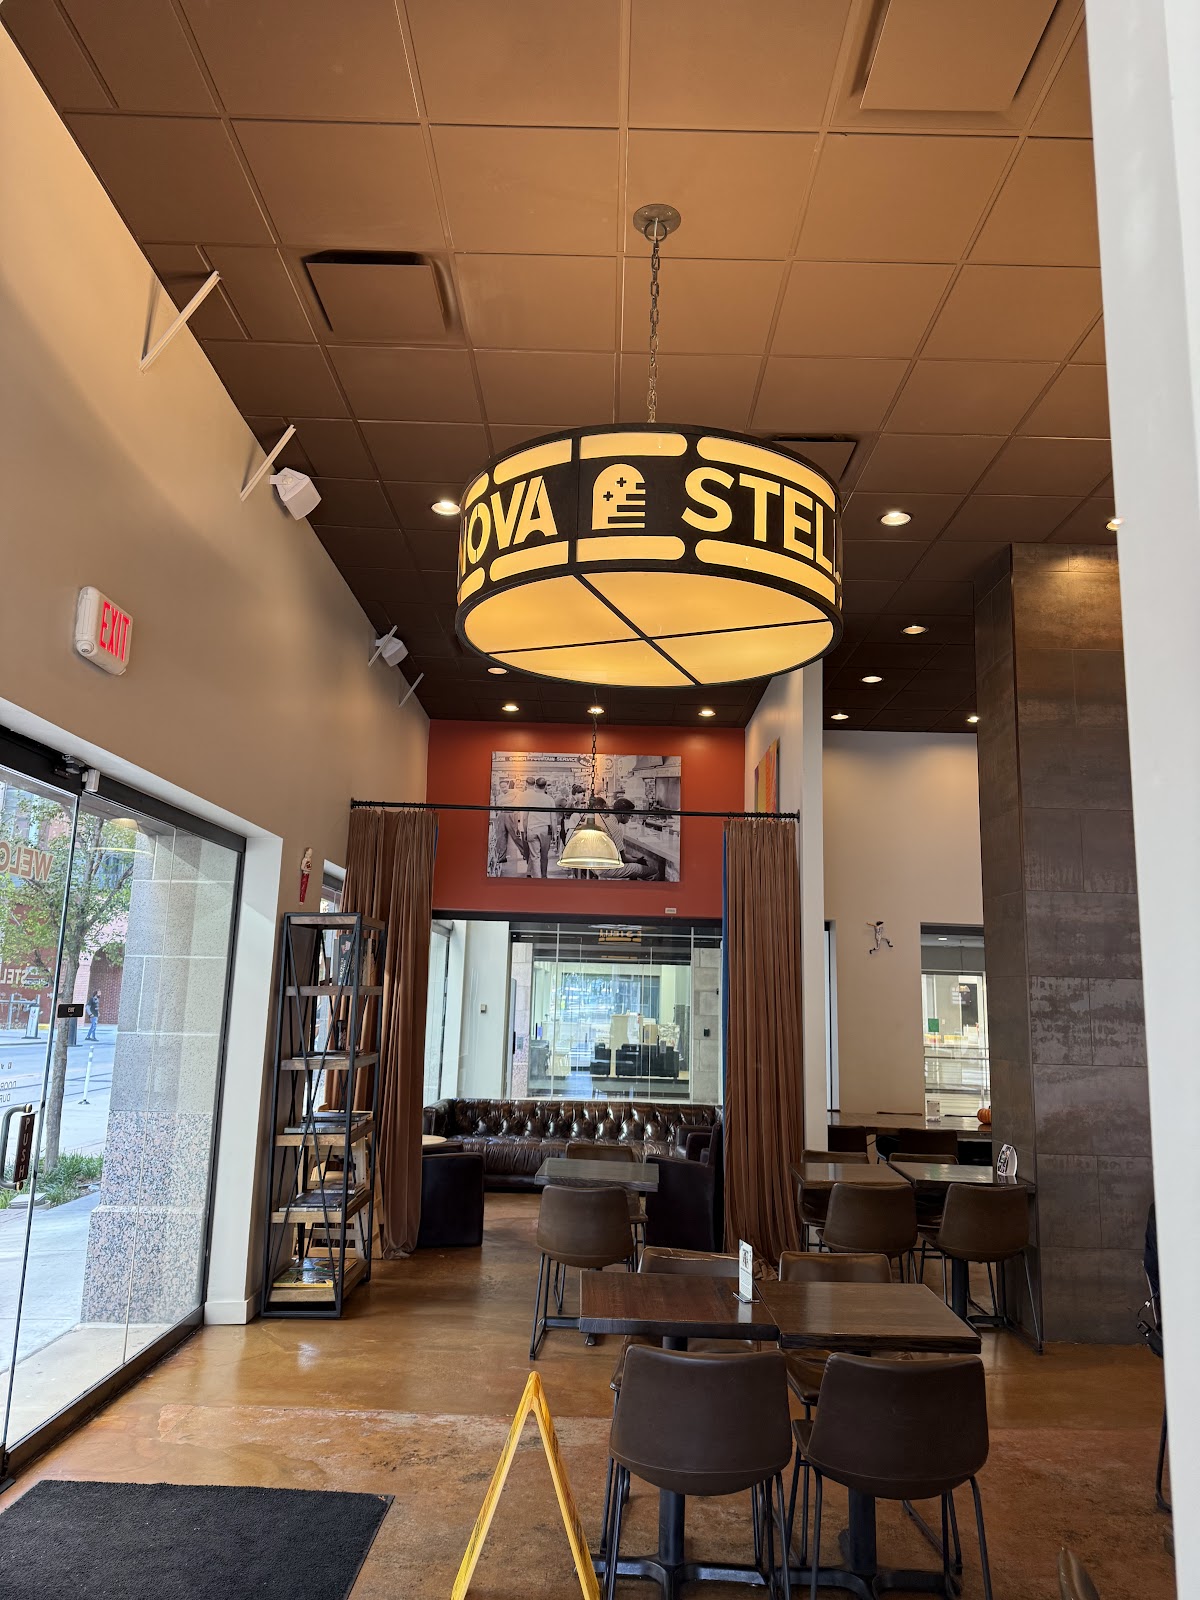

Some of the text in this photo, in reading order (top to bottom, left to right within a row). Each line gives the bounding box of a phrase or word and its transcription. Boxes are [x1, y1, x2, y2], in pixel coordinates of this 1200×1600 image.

[681, 467, 841, 585] STEL
[99, 600, 131, 662] EXIT
[18, 1117, 31, 1179] PUSH
